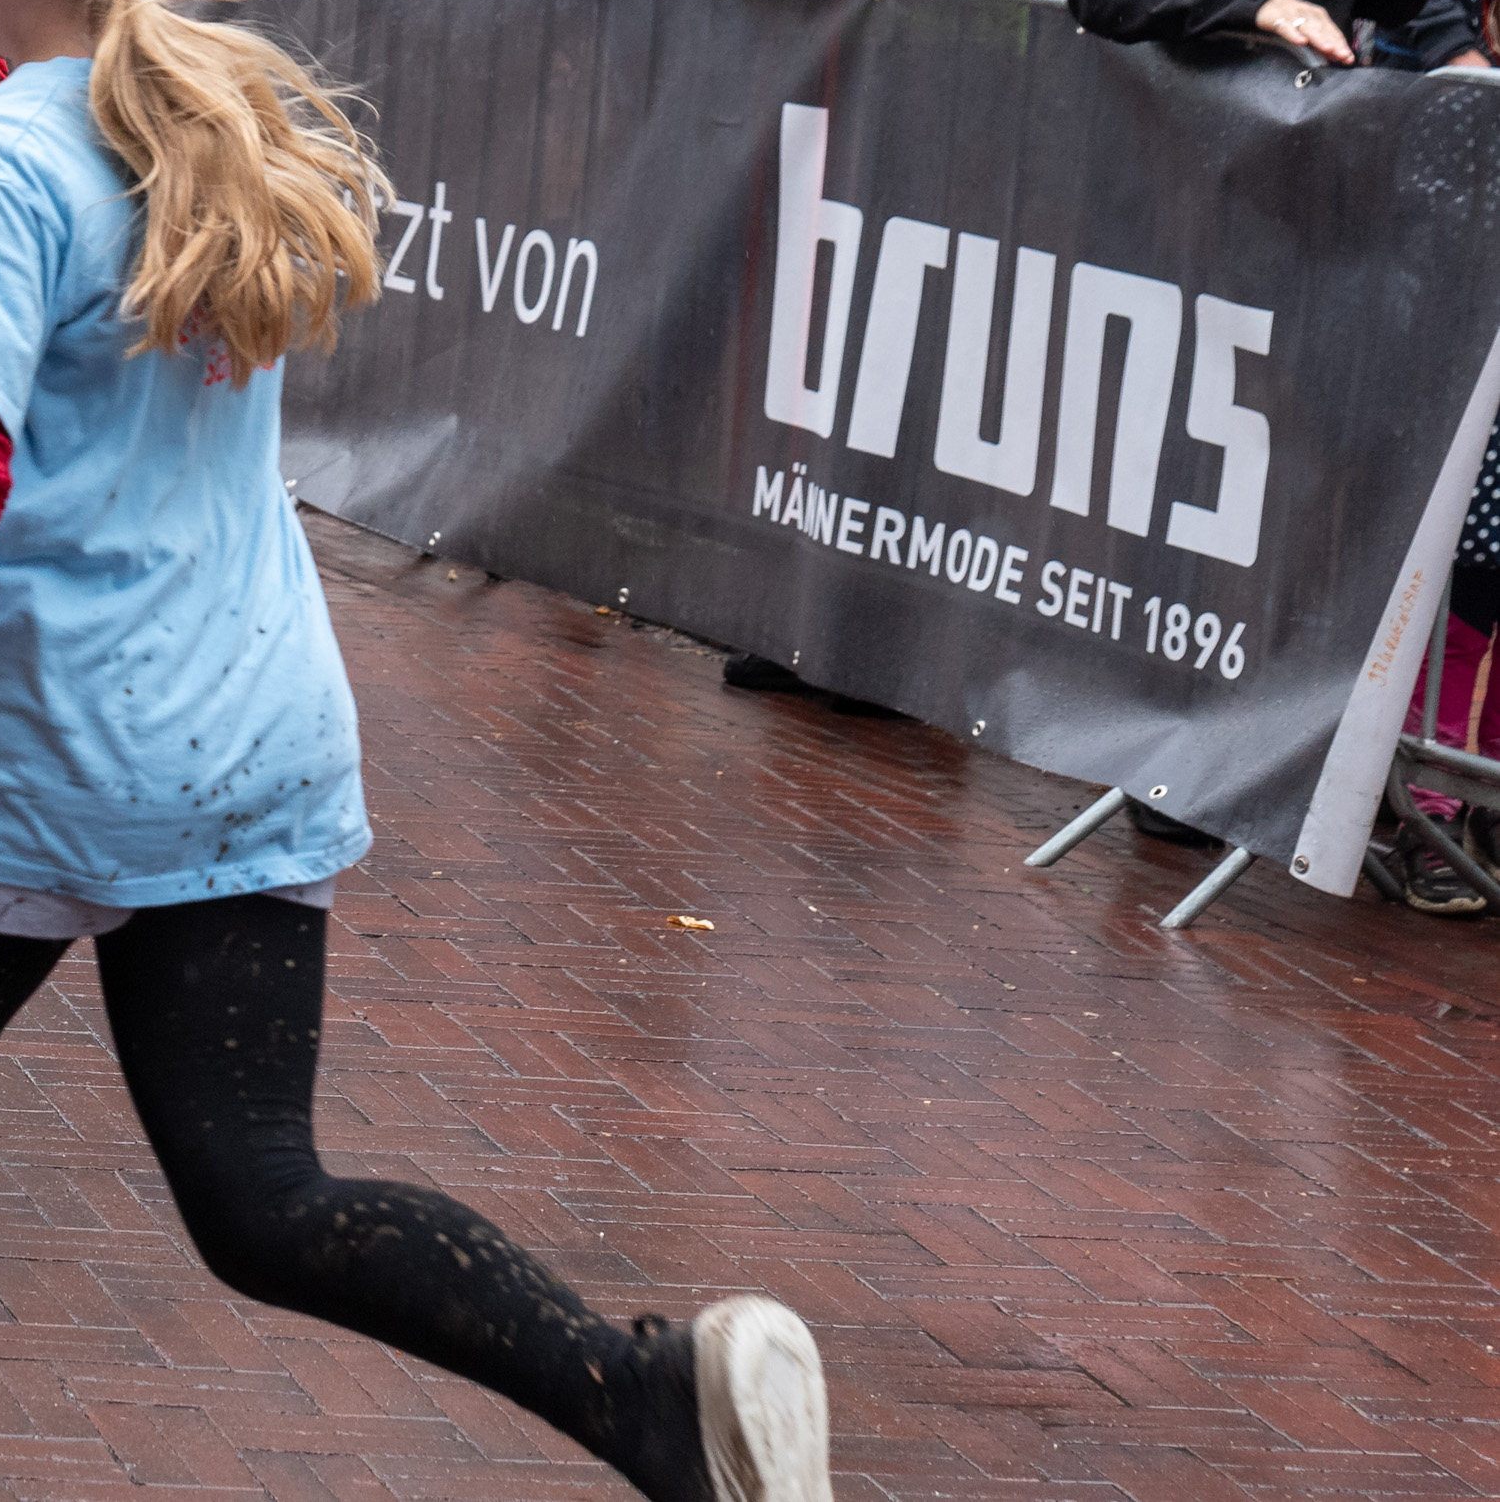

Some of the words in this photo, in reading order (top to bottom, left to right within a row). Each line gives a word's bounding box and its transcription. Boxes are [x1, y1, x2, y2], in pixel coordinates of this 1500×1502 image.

[474, 215, 600, 338] von
[764, 101, 1275, 568] bruns
[1035, 559, 1133, 641] SEIT
[1142, 595, 1248, 680] 1896
